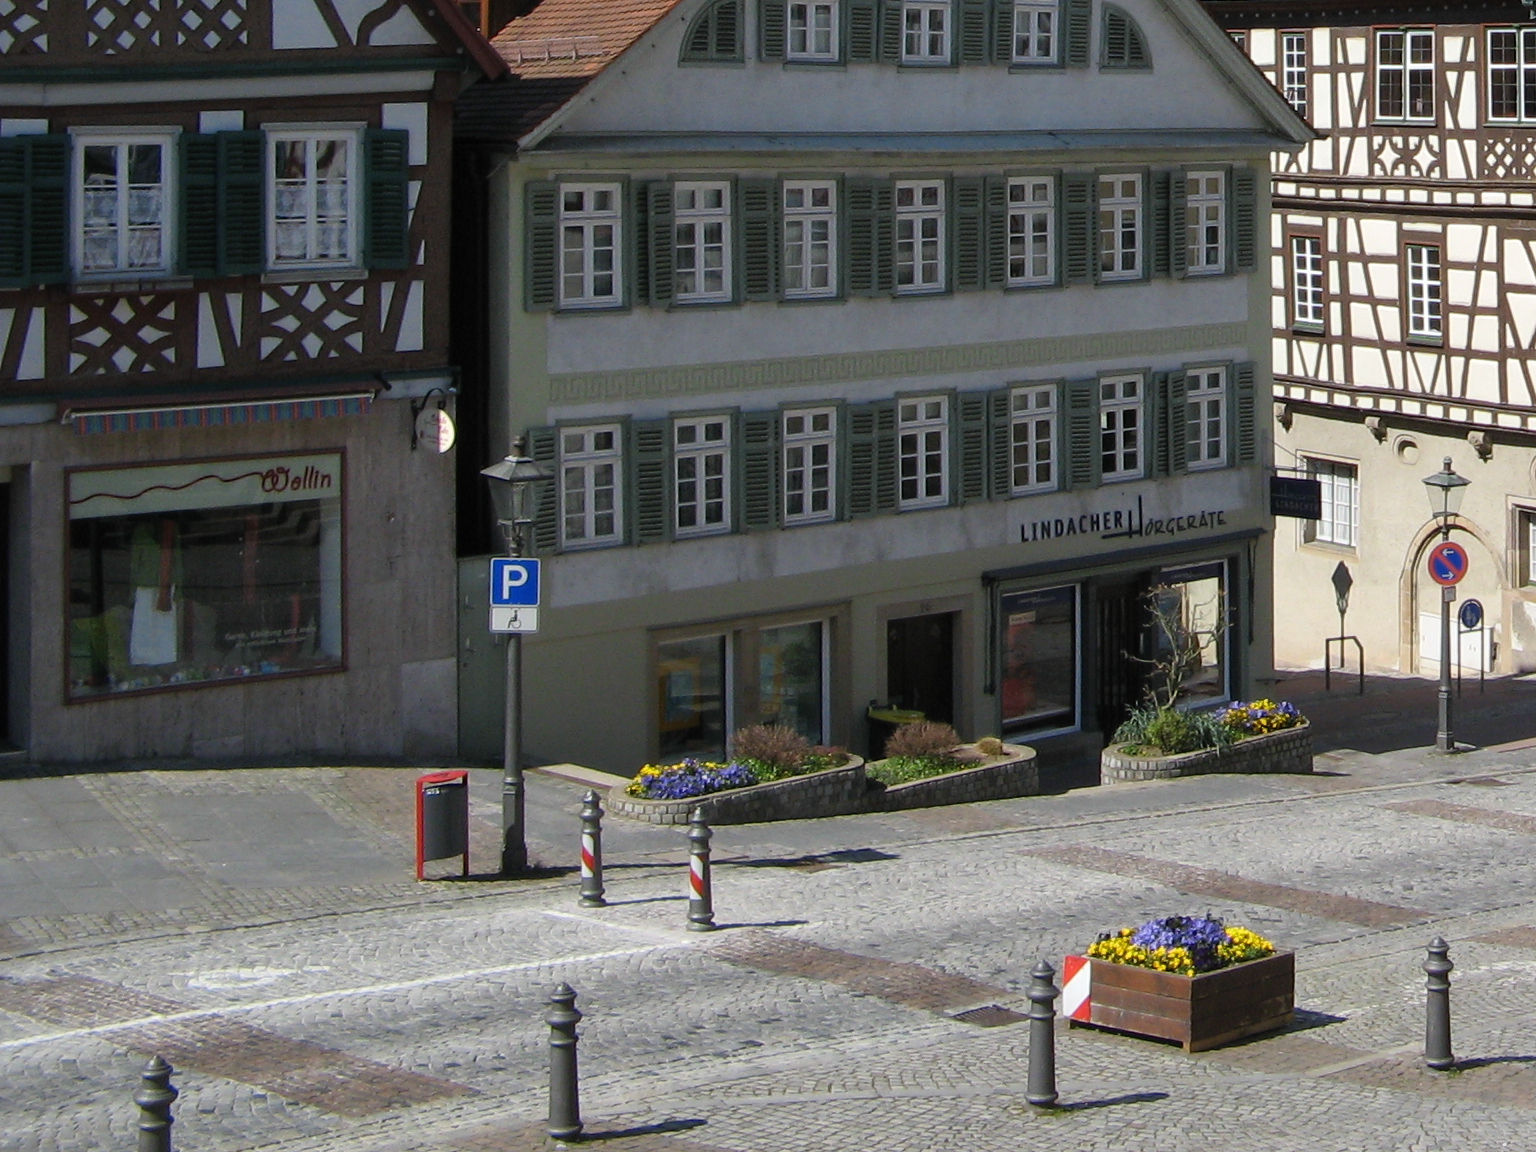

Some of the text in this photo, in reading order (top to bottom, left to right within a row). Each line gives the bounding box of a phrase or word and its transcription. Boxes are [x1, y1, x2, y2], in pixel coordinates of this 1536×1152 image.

[261, 465, 331, 493] Wollin
[1020, 494, 1228, 544] LINDACHER HÖRGERÄTE
[502, 564, 529, 600] P
